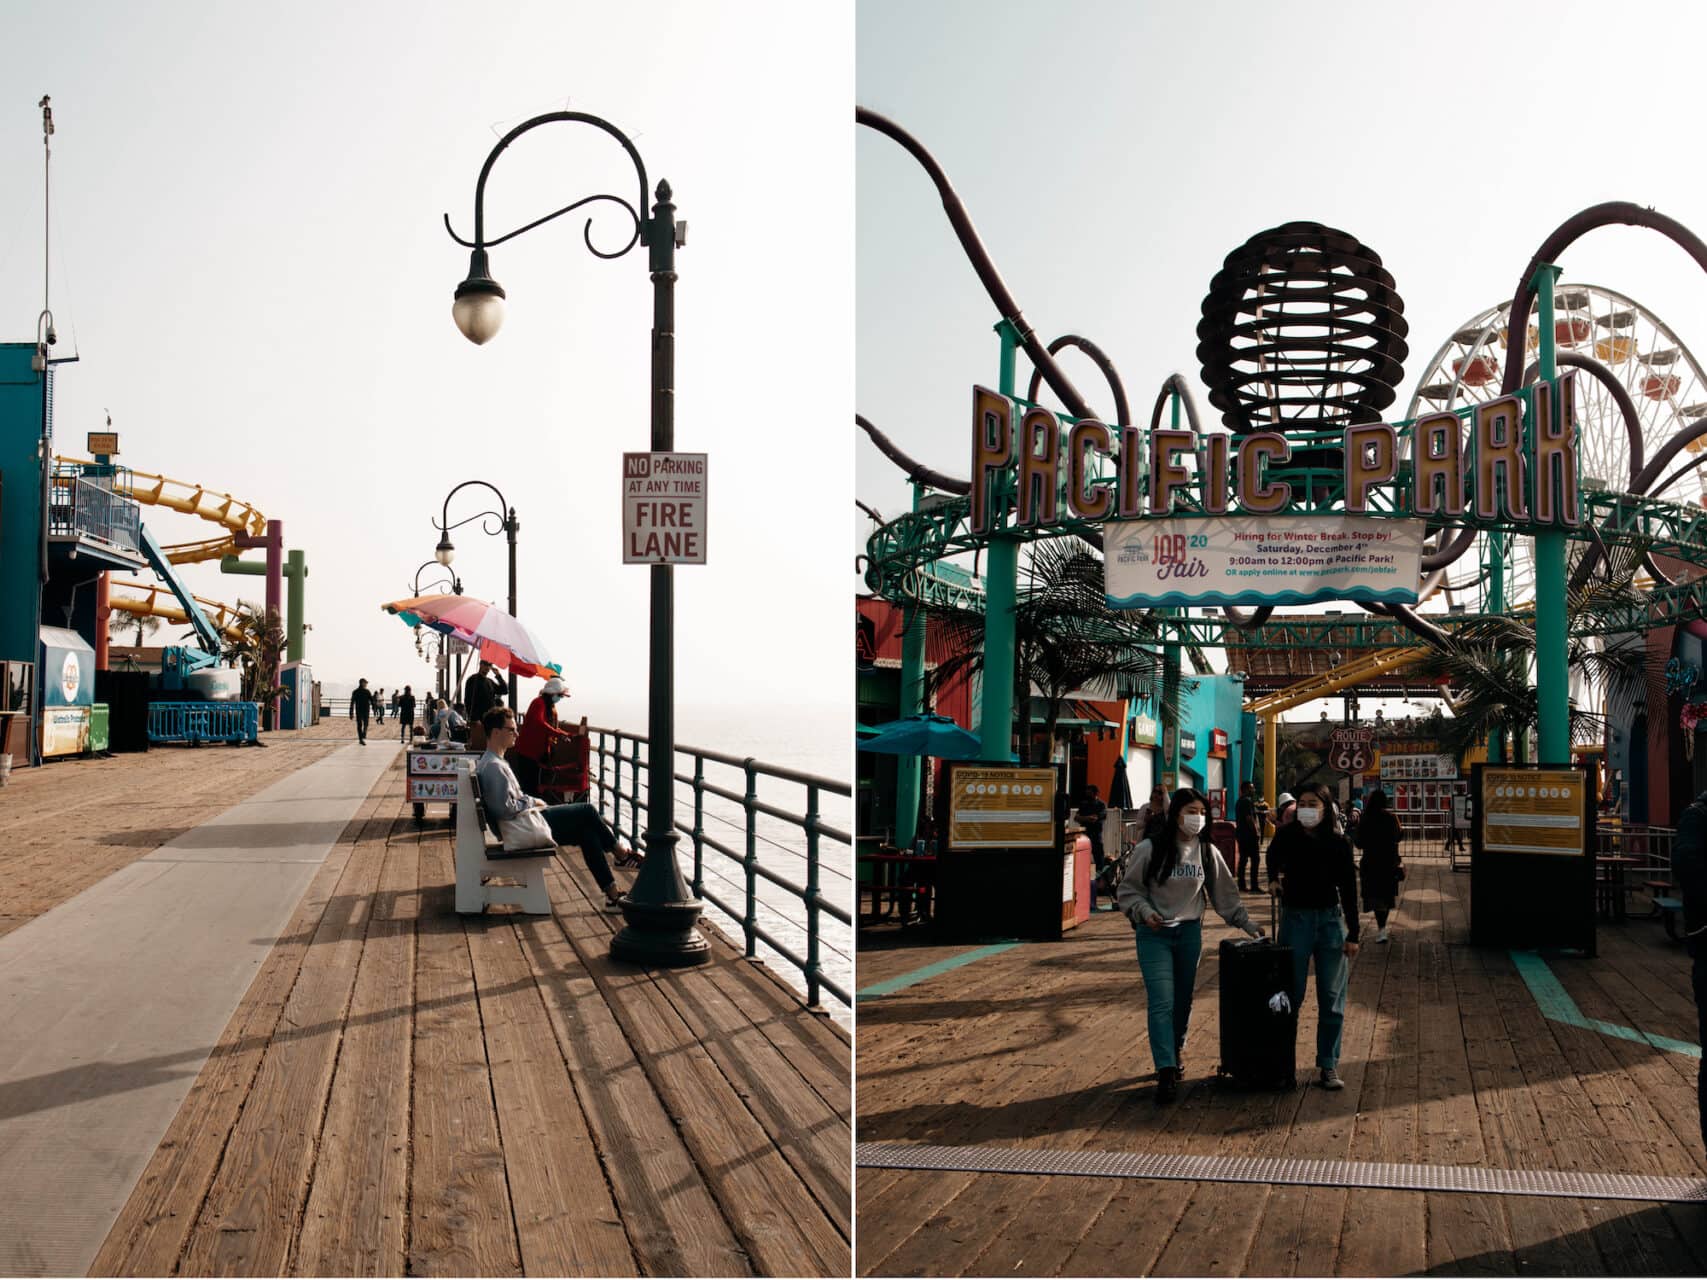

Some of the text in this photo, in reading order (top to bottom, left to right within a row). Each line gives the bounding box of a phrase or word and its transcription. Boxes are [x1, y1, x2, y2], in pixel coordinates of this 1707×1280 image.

[971, 368, 1580, 534] PACIFIC PARK
[628, 458, 703, 475] NO PARKING
[629, 480, 701, 493] AT ANY TIME
[636, 502, 693, 528] FIRE
[631, 532, 698, 557] LANE
[1234, 532, 1265, 543] Hiring
[1267, 532, 1281, 541] for
[1283, 532, 1318, 541] Winter
[1351, 531, 1375, 542] Stop
[1376, 531, 1392, 543] by!
[1152, 534, 1187, 565] JOB
[1256, 544, 1304, 555] Saturday,
[1306, 543, 1353, 553] December
[1157, 555, 1209, 580] Fair
[1229, 557, 1266, 566] 9:00am
[1268, 557, 1279, 565] to
[1281, 557, 1324, 567] 12:00pm
[1335, 555, 1367, 564] Pacific
[1369, 555, 1394, 563] Park!
[1239, 569, 1261, 578] apply
[1262, 568, 1287, 576] online
[1336, 731, 1366, 741] ROUTE
[1337, 751, 1366, 769] 66
